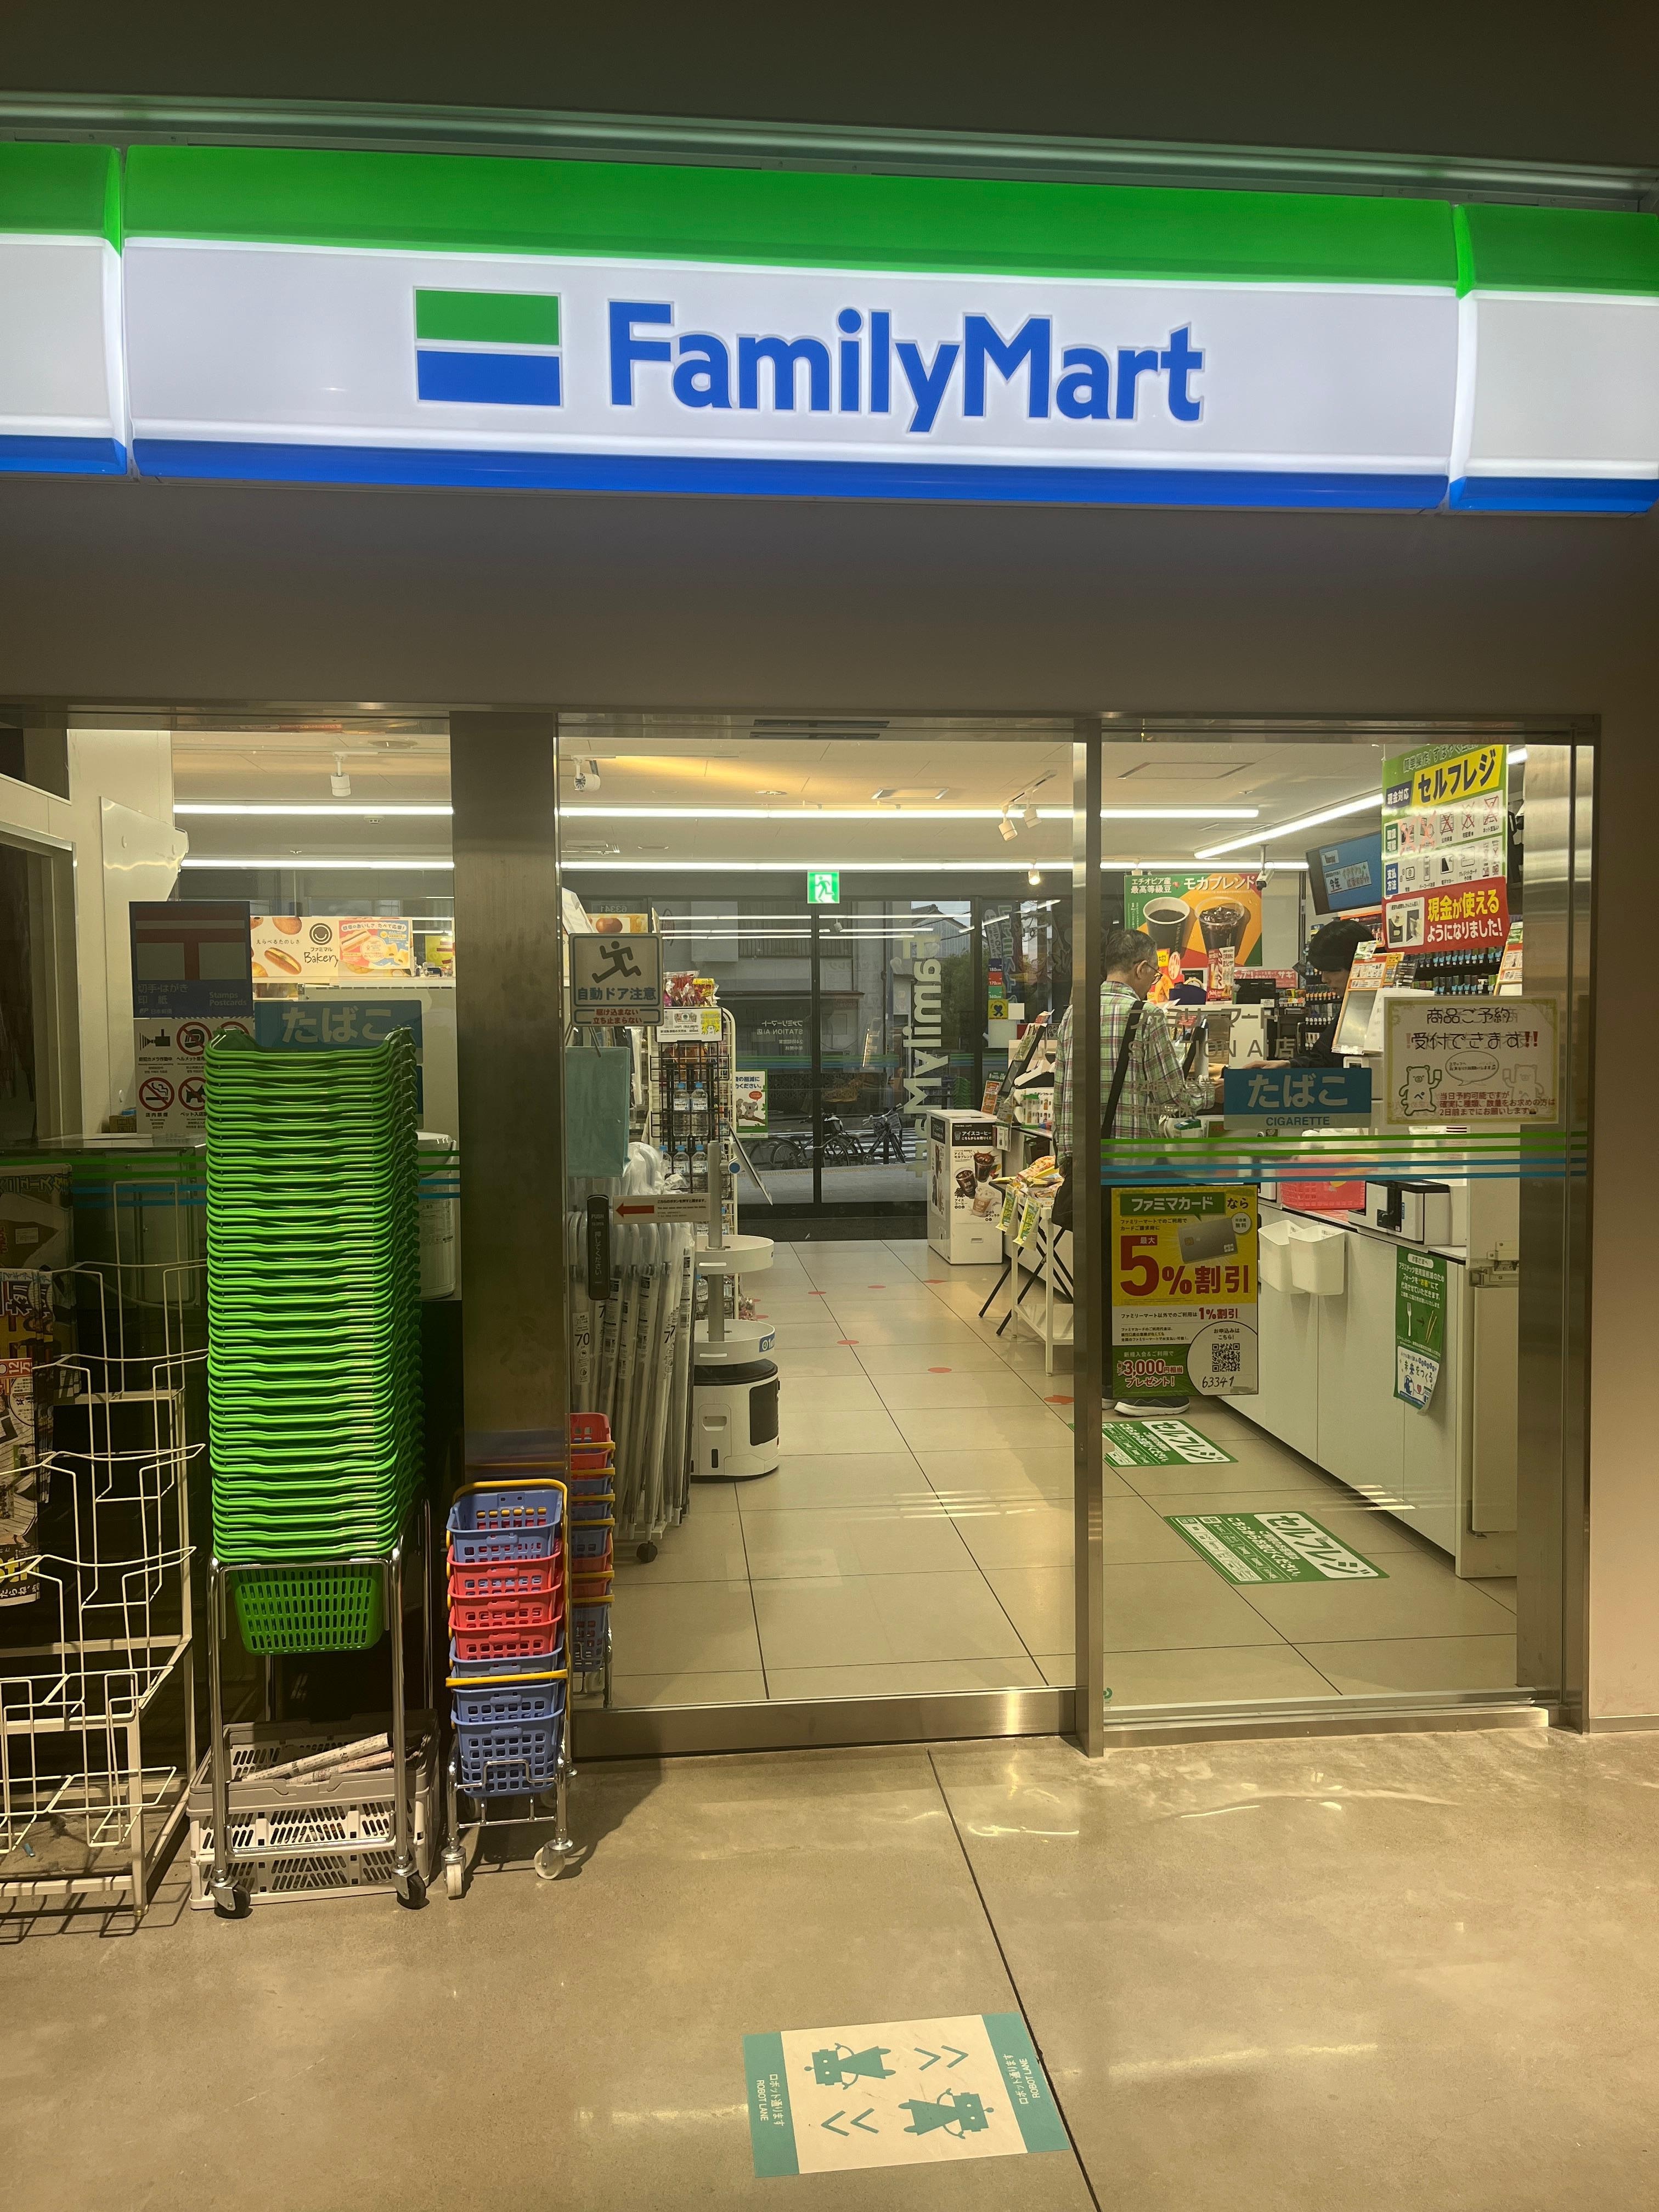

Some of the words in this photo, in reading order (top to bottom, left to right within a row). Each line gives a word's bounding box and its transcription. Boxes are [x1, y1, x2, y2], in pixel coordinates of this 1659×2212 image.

[609, 300, 1203, 433] FamilyMart
[1418, 748, 1496, 803] セルフレジ
[1387, 788, 1409, 804] 現金対応
[1130, 885, 1172, 894] 最高等級豆
[1183, 876, 1255, 891] モカブレンド
[1427, 889, 1499, 922] 現金が使える
[1427, 918, 1503, 943] ようになりました!
[304, 952, 339, 967] Bakery
[210, 991, 239, 1000] Stamps
[210, 998, 247, 1007] Postcards
[578, 988, 657, 1001] 自動ドア注意
[1427, 1007, 1510, 1024] 商品ご予約
[281, 1007, 391, 1043] たばこ
[1128, 1040, 1237, 1058] STATION
[1247, 1073, 1348, 1108] たばこ
[1440, 1091, 1510, 1100] 当日予約可能ですが
[1440, 1099, 1555, 1108] 確実に種類、数量をお求めの方は
[1440, 1108, 1530, 1116] 2日前までにお願いします
[1266, 1116, 1330, 1126] CIGARETTE
[1131, 1196, 1214, 1212] ファミマカード
[1227, 1197, 1249, 1210] なら
[1120, 1234, 1249, 1296] 5%割引
[1199, 1307, 1239, 1320] 1%割引
[574, 1332, 590, 1346] 70
[1124, 1359, 1183, 1376] 3,000円相当
[1126, 1376, 1175, 1388] プレゼント!
[1202, 1375, 1235, 1389] 63341
[1151, 1421, 1224, 1461] セルフレジ
[1266, 1515, 1371, 1575] セルフレジ
[1019, 2058, 1032, 2076] LANE
[1003, 2053, 1029, 2105] ロボット通ります
[1026, 2076, 1041, 2099] ROBOT
[757, 2079, 767, 2102] ROBOT
[769, 2074, 785, 2127] ロボット通ります
[759, 2102, 769, 2121] LANE
